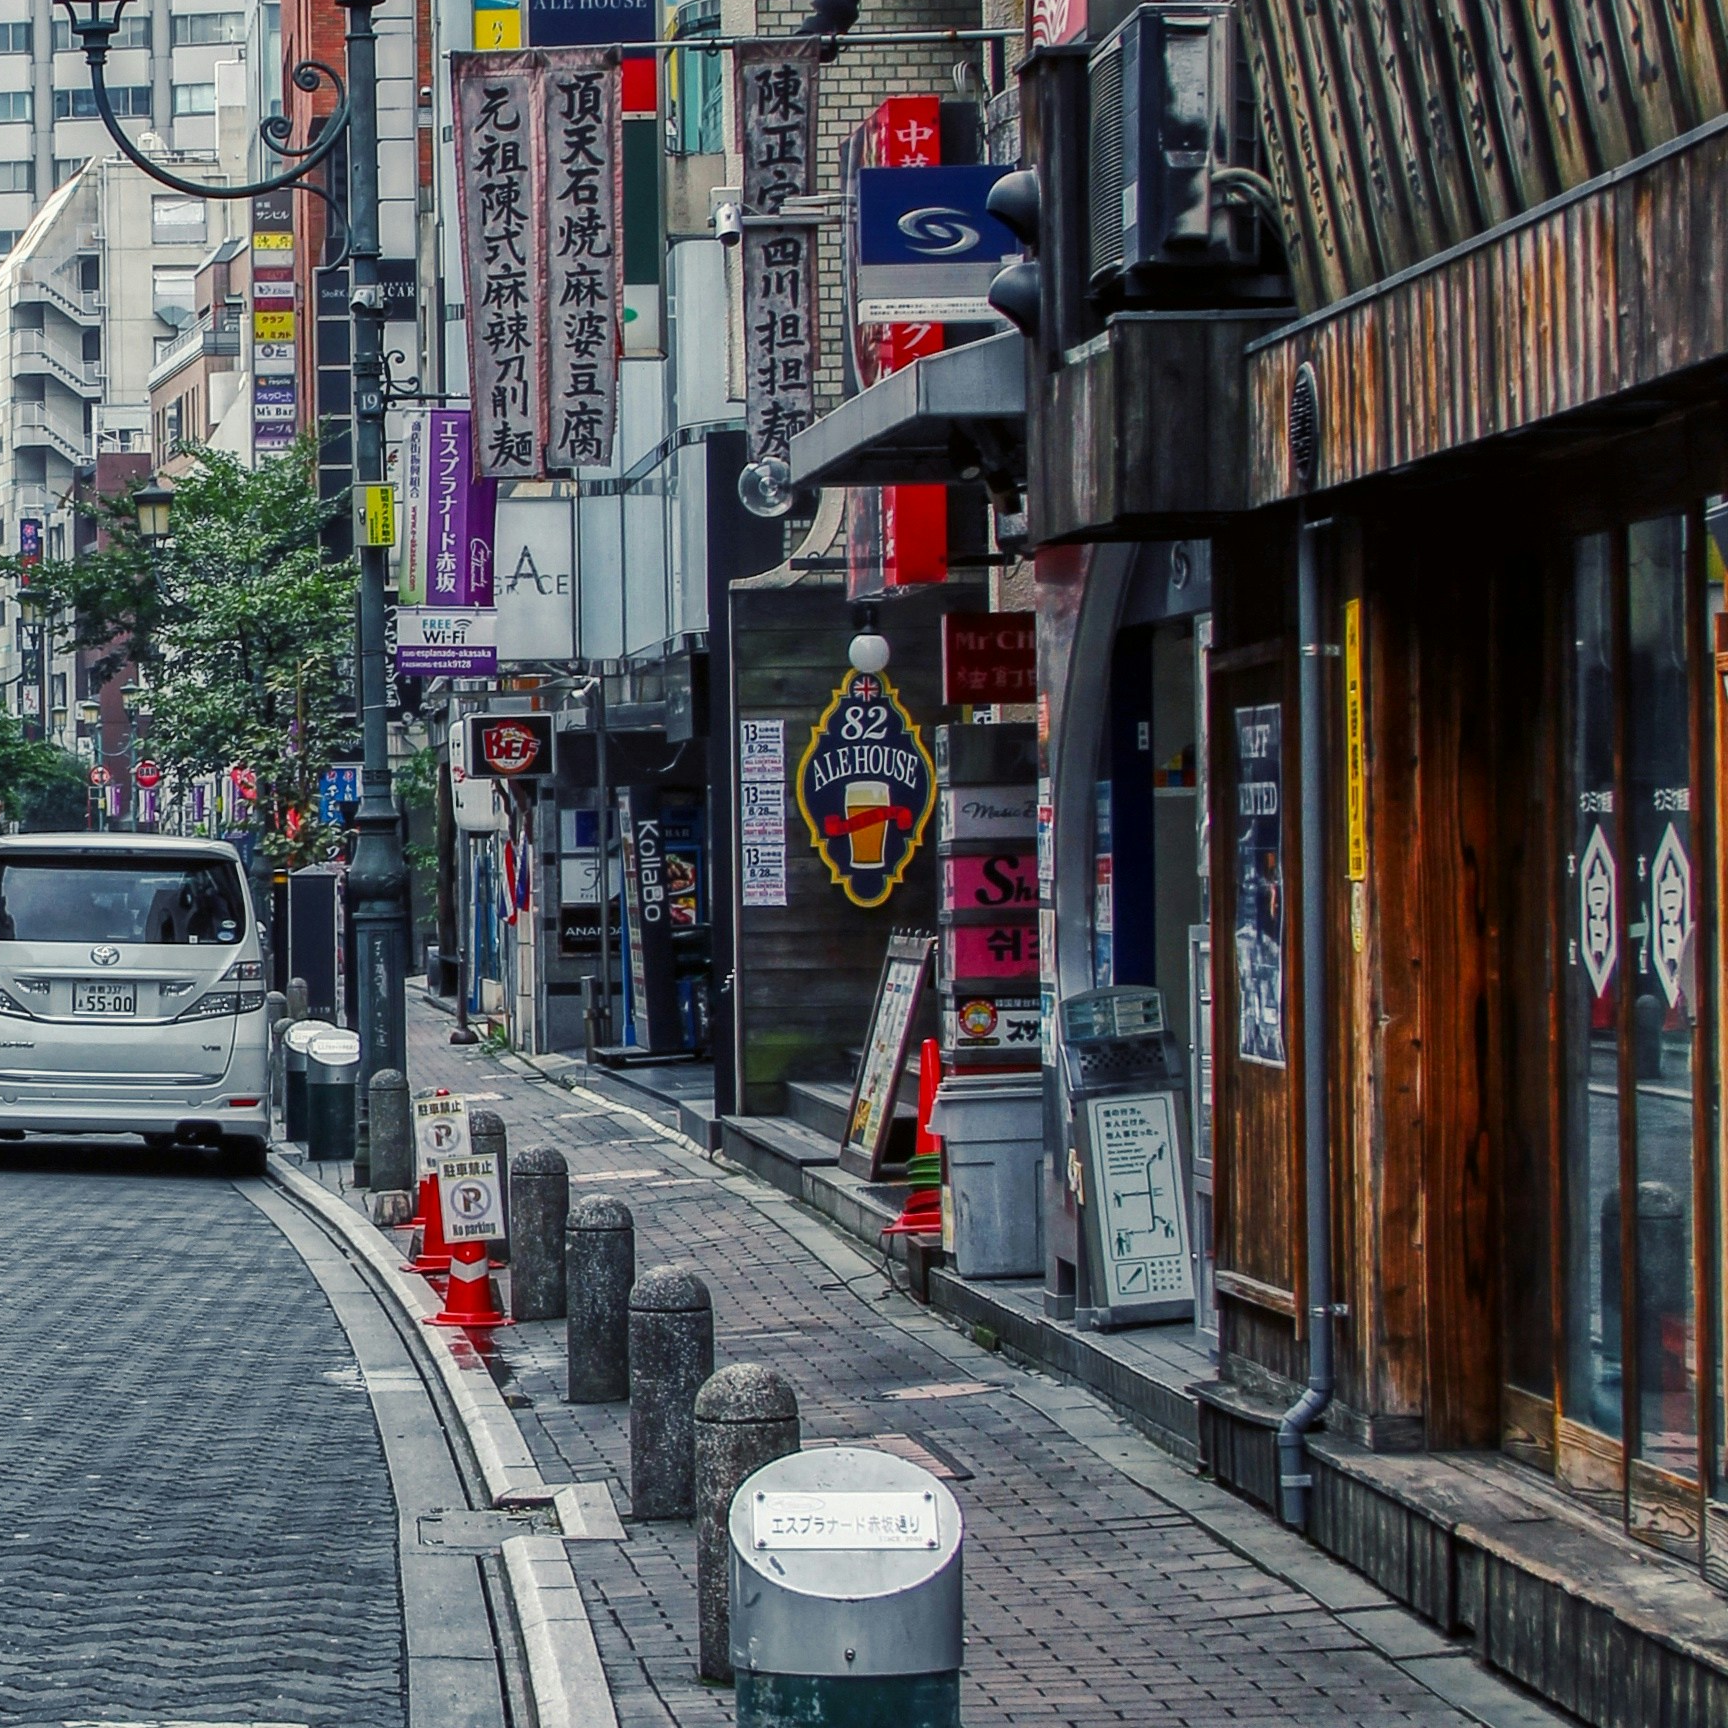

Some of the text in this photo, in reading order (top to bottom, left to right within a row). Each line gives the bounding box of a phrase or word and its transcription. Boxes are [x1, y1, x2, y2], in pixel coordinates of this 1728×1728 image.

[256, 210, 290, 221] サンビル
[556, 72, 613, 462] 頂天石焼麻婆豆腐
[361, 394, 378, 411] 19
[435, 420, 460, 594] エスプラナード赤坂
[423, 618, 452, 631] FREE
[423, 630, 466, 645] Wi-Fi
[744, 723, 758, 741] 13
[840, 705, 889, 741] 82
[812, 744, 919, 792] ALE HOUSE
[745, 786, 759, 804] 13
[746, 847, 760, 865] 13
[637, 819, 665, 923] KollaBo
[86, 995, 133, 1012] 55-00
[417, 1100, 462, 1117] 駐車禁止
[443, 1160, 494, 1178] 駐車禁止
[463, 1222, 497, 1237] parking
[771, 1514, 920, 1535] エスプラナード赤坂通り
